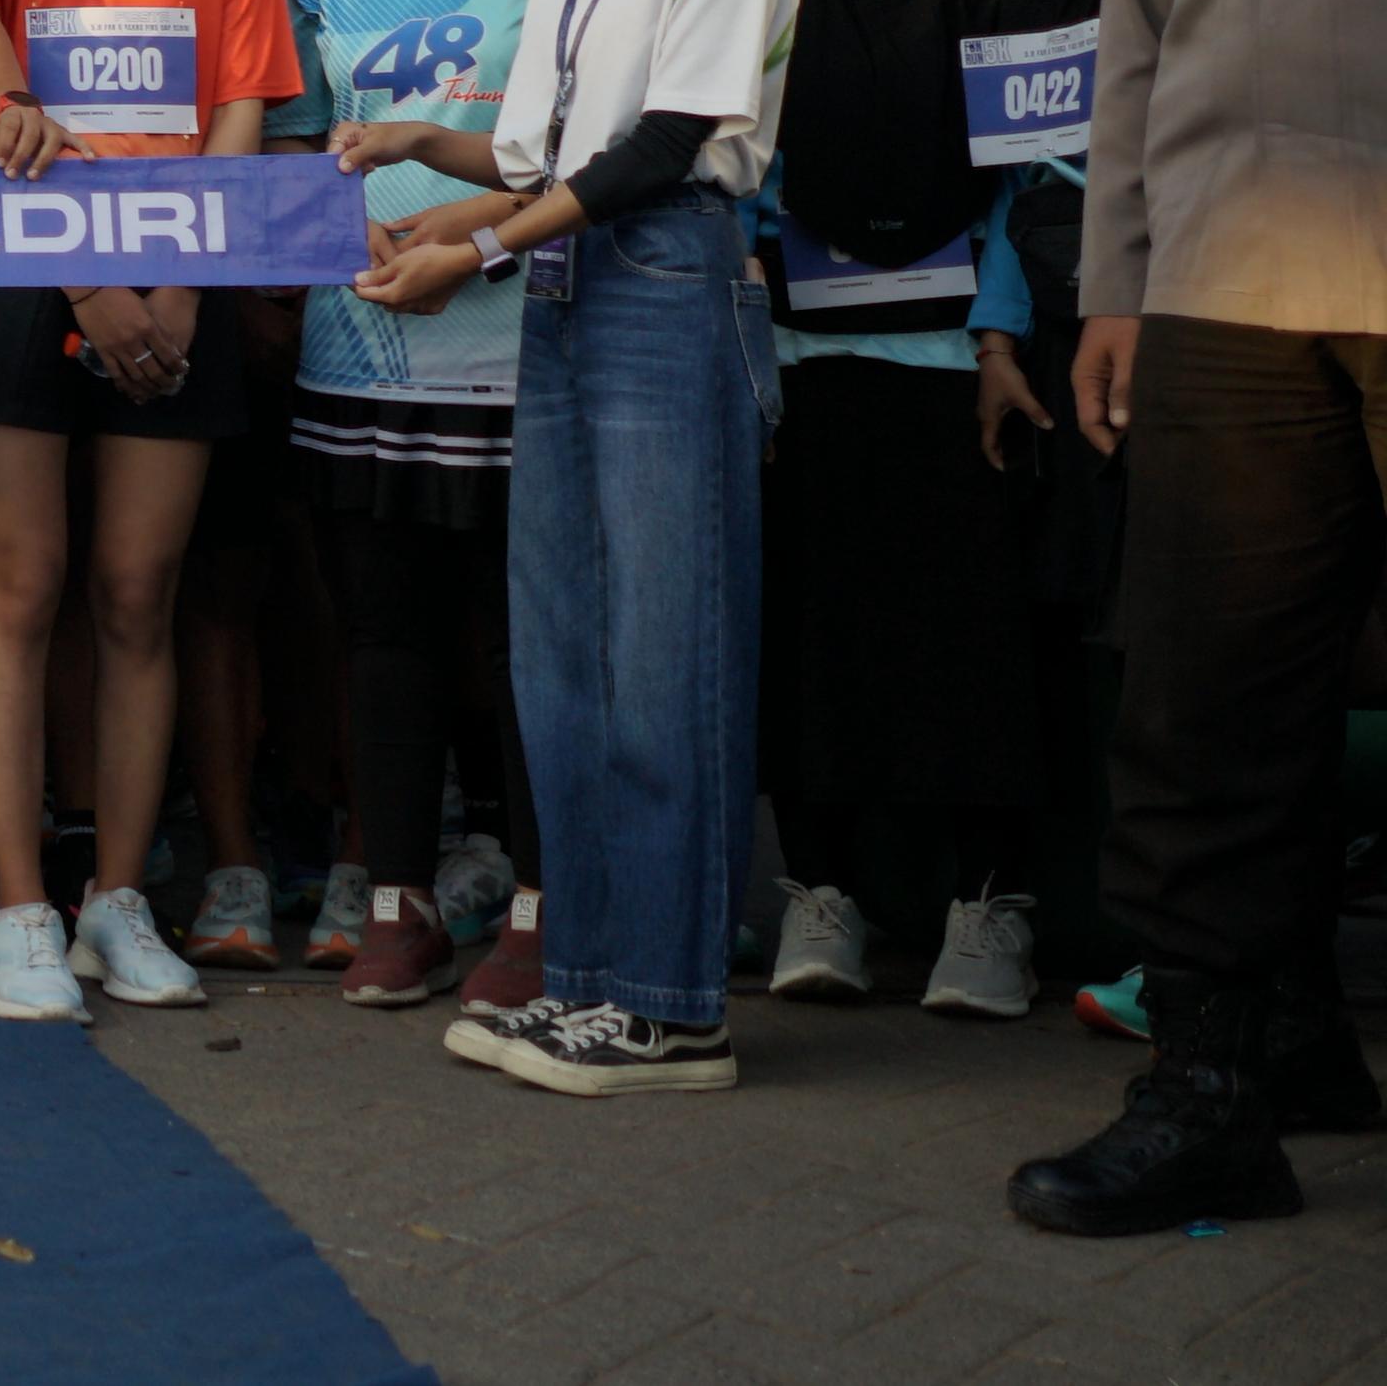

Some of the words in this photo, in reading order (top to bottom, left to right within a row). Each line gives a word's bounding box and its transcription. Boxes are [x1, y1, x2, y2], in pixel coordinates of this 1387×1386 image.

[69, 46, 164, 92] 0200
[352, 13, 486, 105] 48
[443, 77, 505, 103] Tahun
[1004, 66, 1082, 120] 0422
